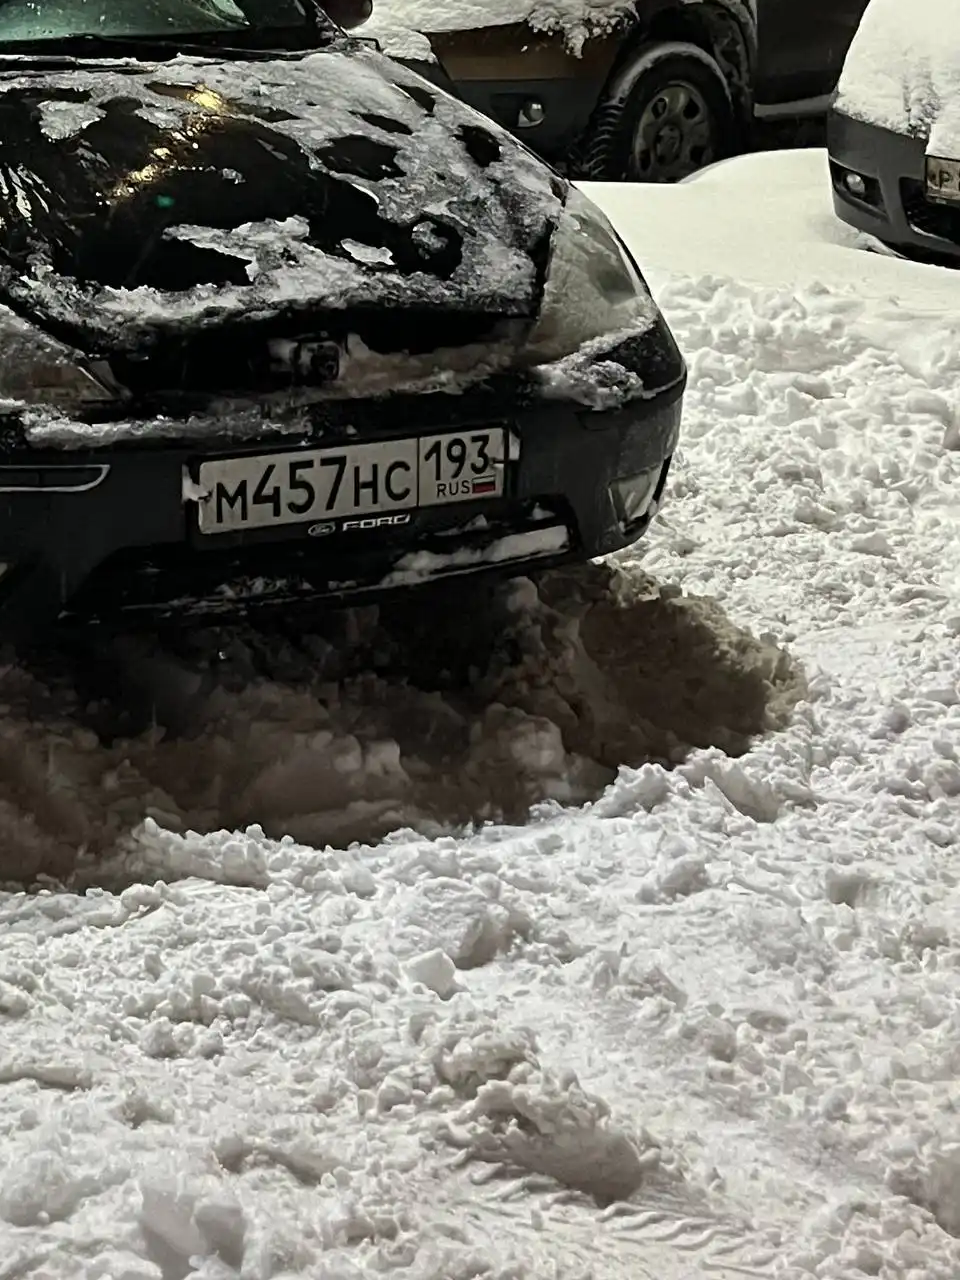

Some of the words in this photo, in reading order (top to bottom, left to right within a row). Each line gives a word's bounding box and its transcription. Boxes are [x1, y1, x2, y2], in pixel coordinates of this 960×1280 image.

[215, 455, 411, 523] М457НС
[424, 435, 490, 481] 193
[436, 480, 471, 498] RUS
[342, 513, 411, 532] FORD
